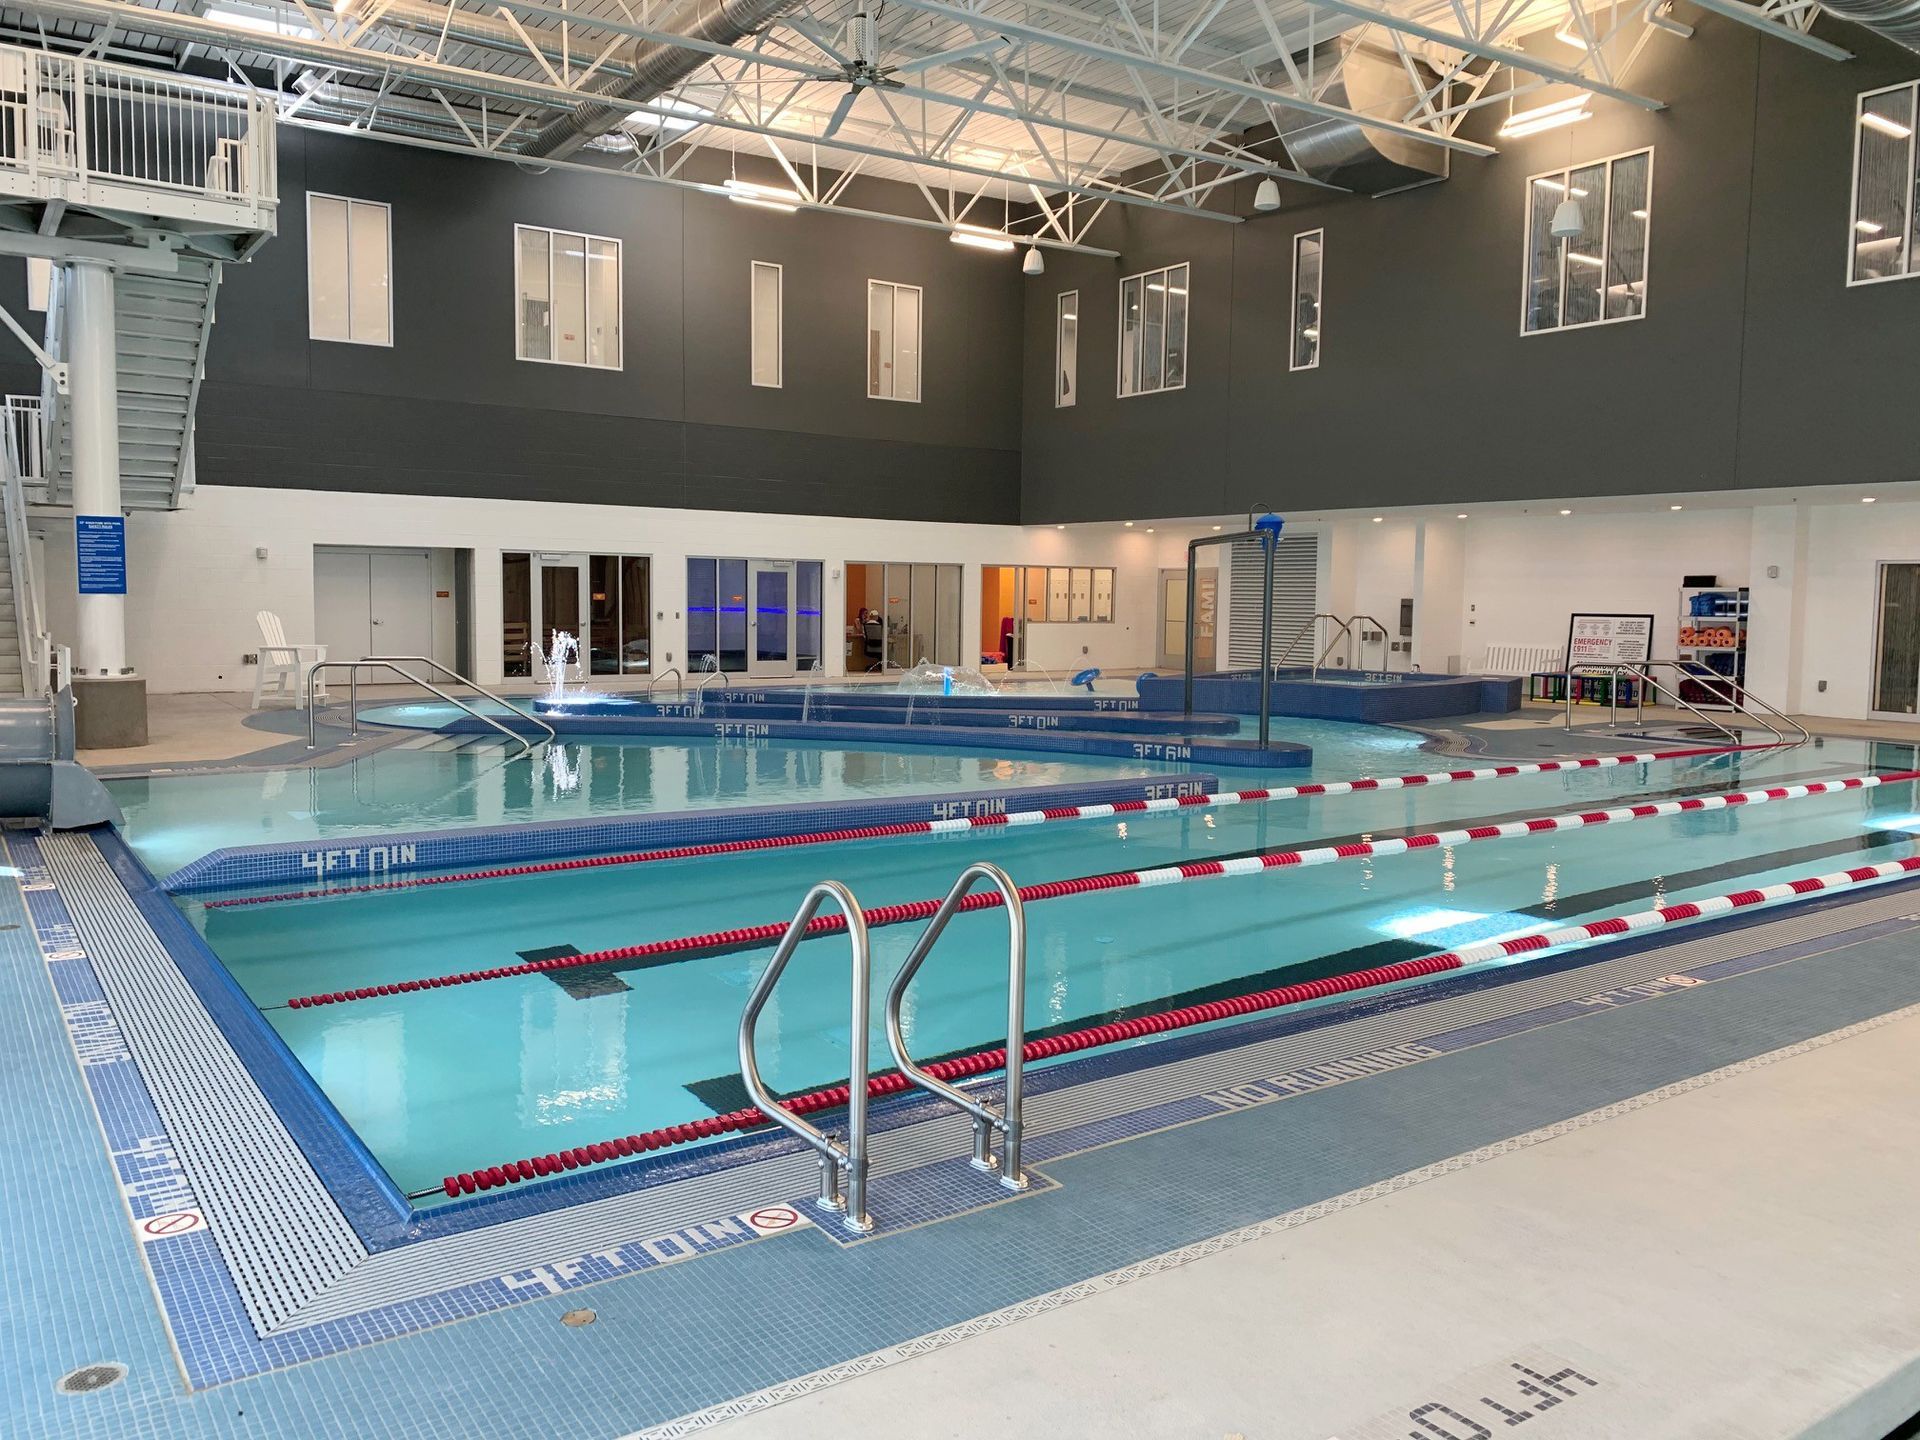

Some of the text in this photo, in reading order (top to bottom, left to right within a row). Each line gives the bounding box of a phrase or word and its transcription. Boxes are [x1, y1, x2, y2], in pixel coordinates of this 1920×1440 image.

[1573, 638, 1612, 646] EMERGENCY
[725, 693, 745, 703] 3FT
[1094, 700, 1117, 711] 3FT
[656, 705, 681, 717] 3FT
[1008, 715, 1059, 729] 3FT 0IN
[715, 724, 769, 738] 3FT 6IN
[1133, 743, 1191, 760] 3FT 6IN
[1145, 782, 1203, 800] 3FT 6IN
[933, 800, 971, 821] 4FT
[302, 849, 360, 876] 4FT
[1571, 990, 1632, 1007] 4FT
[1200, 1042, 1443, 1110] NO RUNNING
[500, 1248, 627, 1294] 4FT
